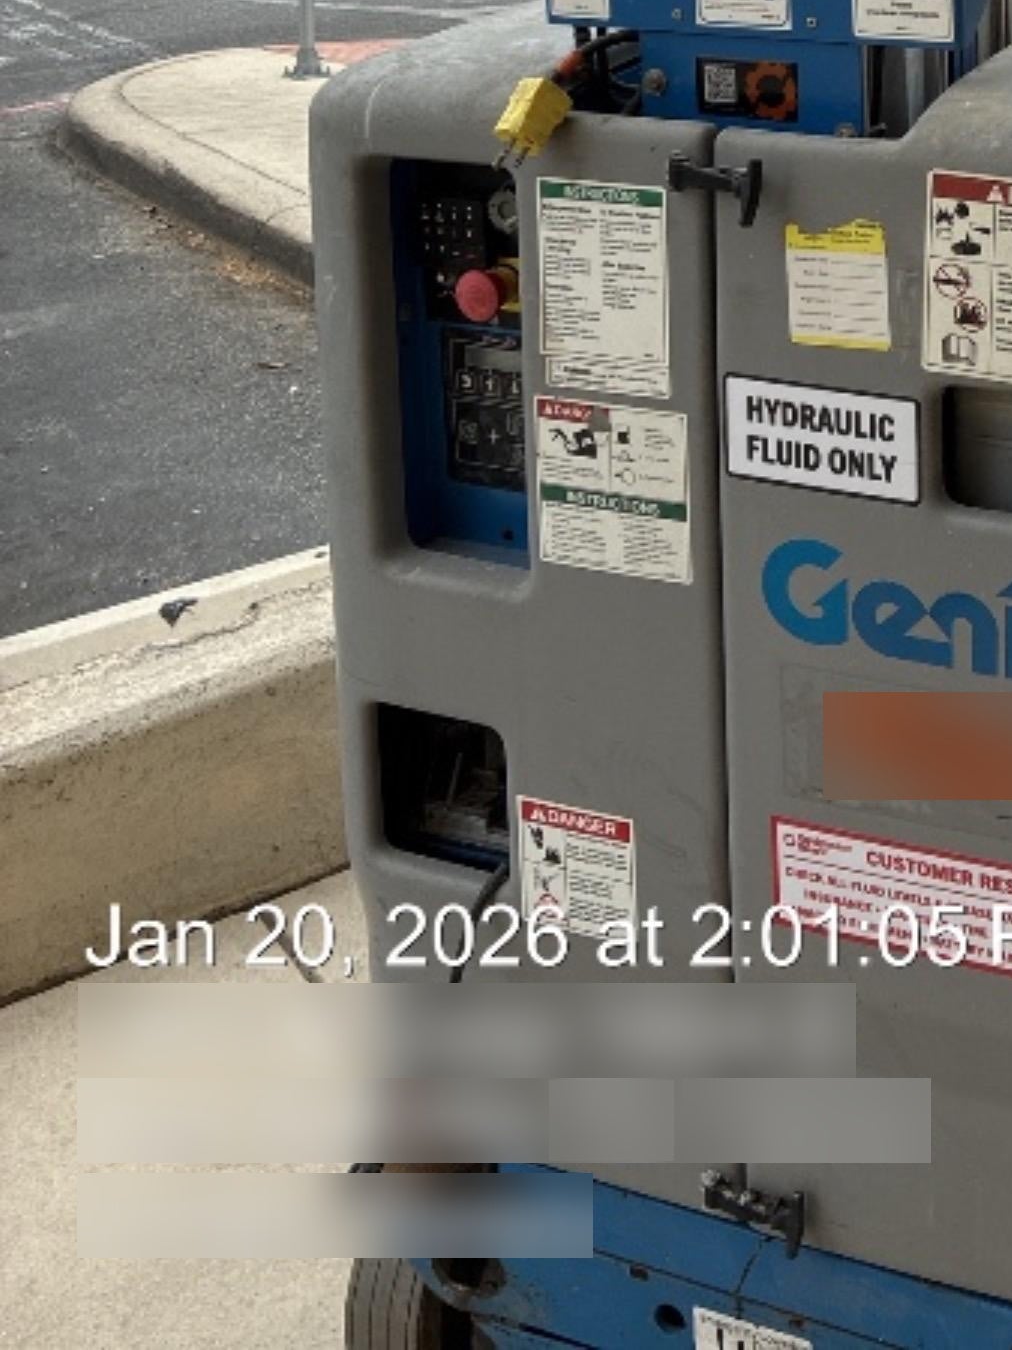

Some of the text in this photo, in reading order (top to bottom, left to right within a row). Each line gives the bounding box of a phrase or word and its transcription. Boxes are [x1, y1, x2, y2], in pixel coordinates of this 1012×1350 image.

[746, 395, 895, 442] HYDRAULIC
[746, 435, 897, 483] FLUID ONLY
[866, 851, 974, 887] CUSTOMER
